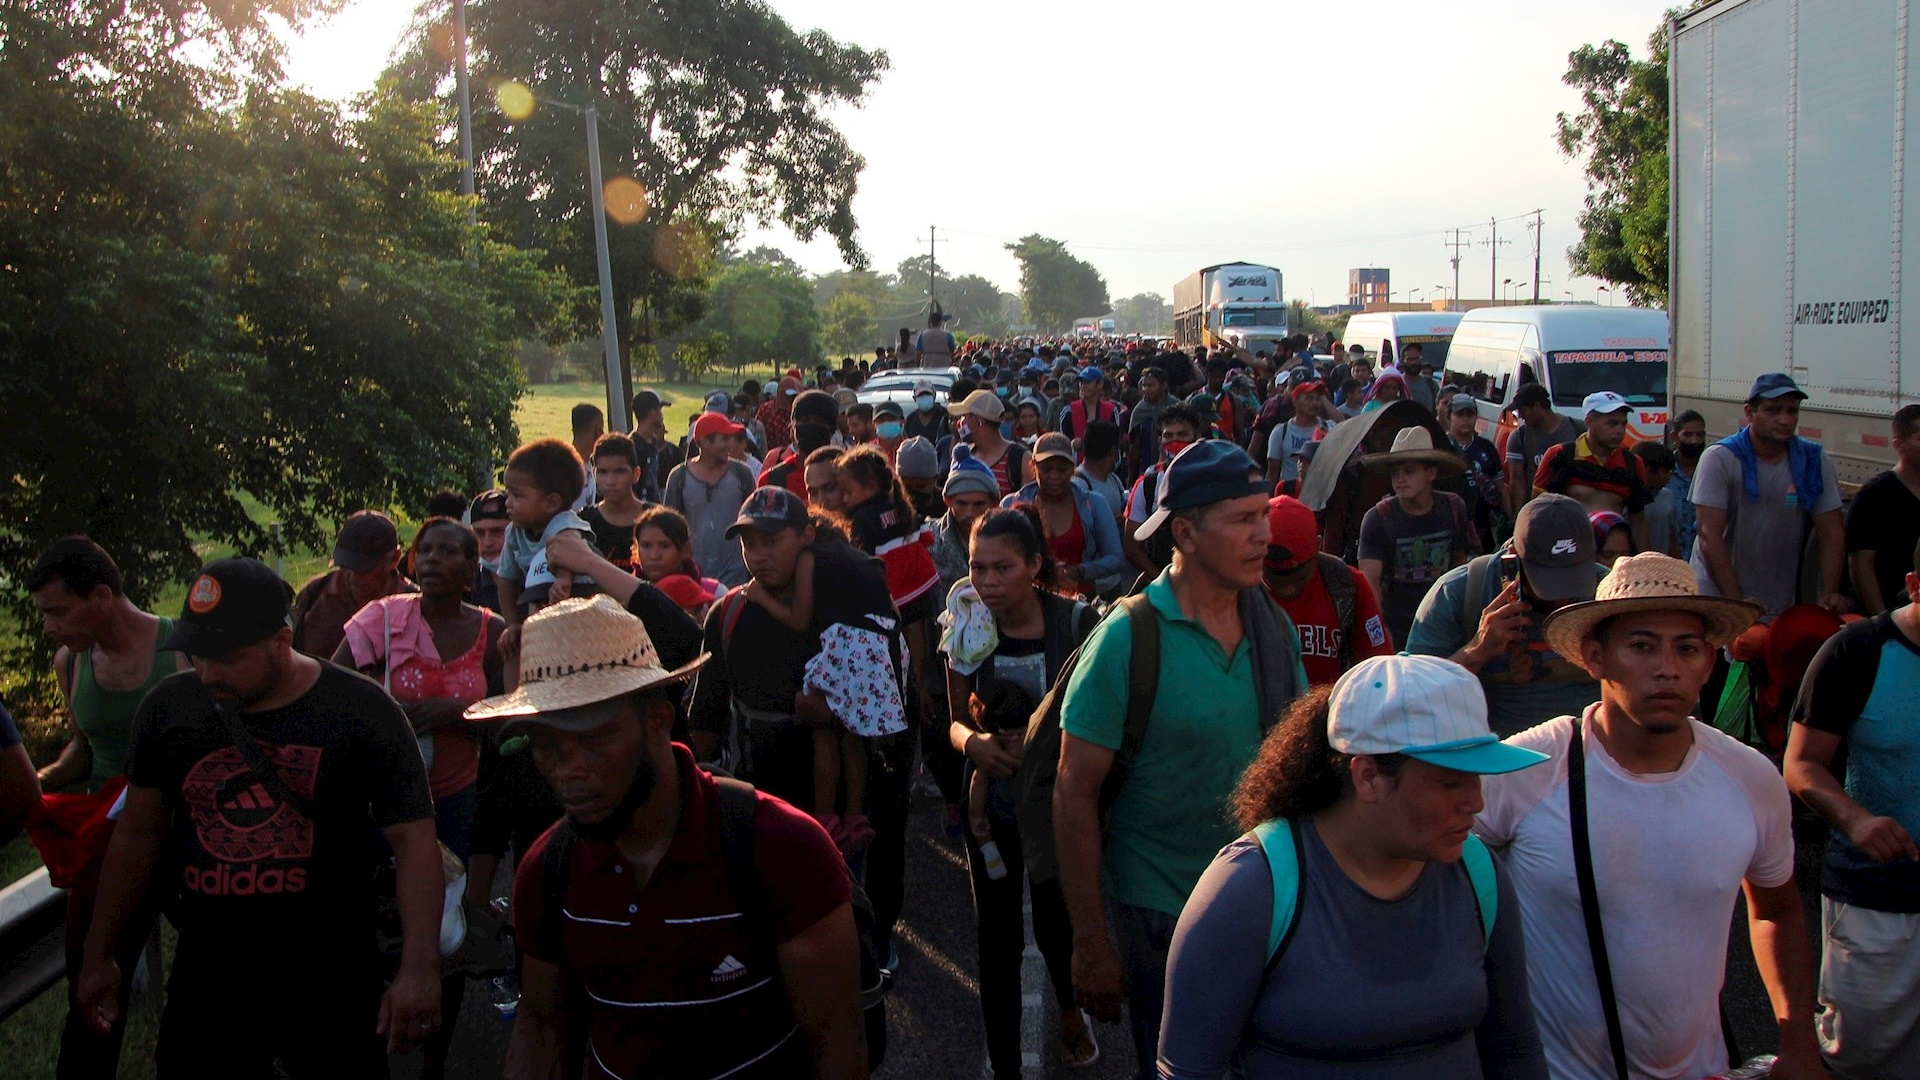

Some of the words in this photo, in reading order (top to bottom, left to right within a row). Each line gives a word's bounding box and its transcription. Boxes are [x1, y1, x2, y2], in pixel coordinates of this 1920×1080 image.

[1794, 302, 1835, 325] AIR-RIDE
[1837, 299, 1889, 325] EQUIPPED
[184, 863, 307, 895] adidas
